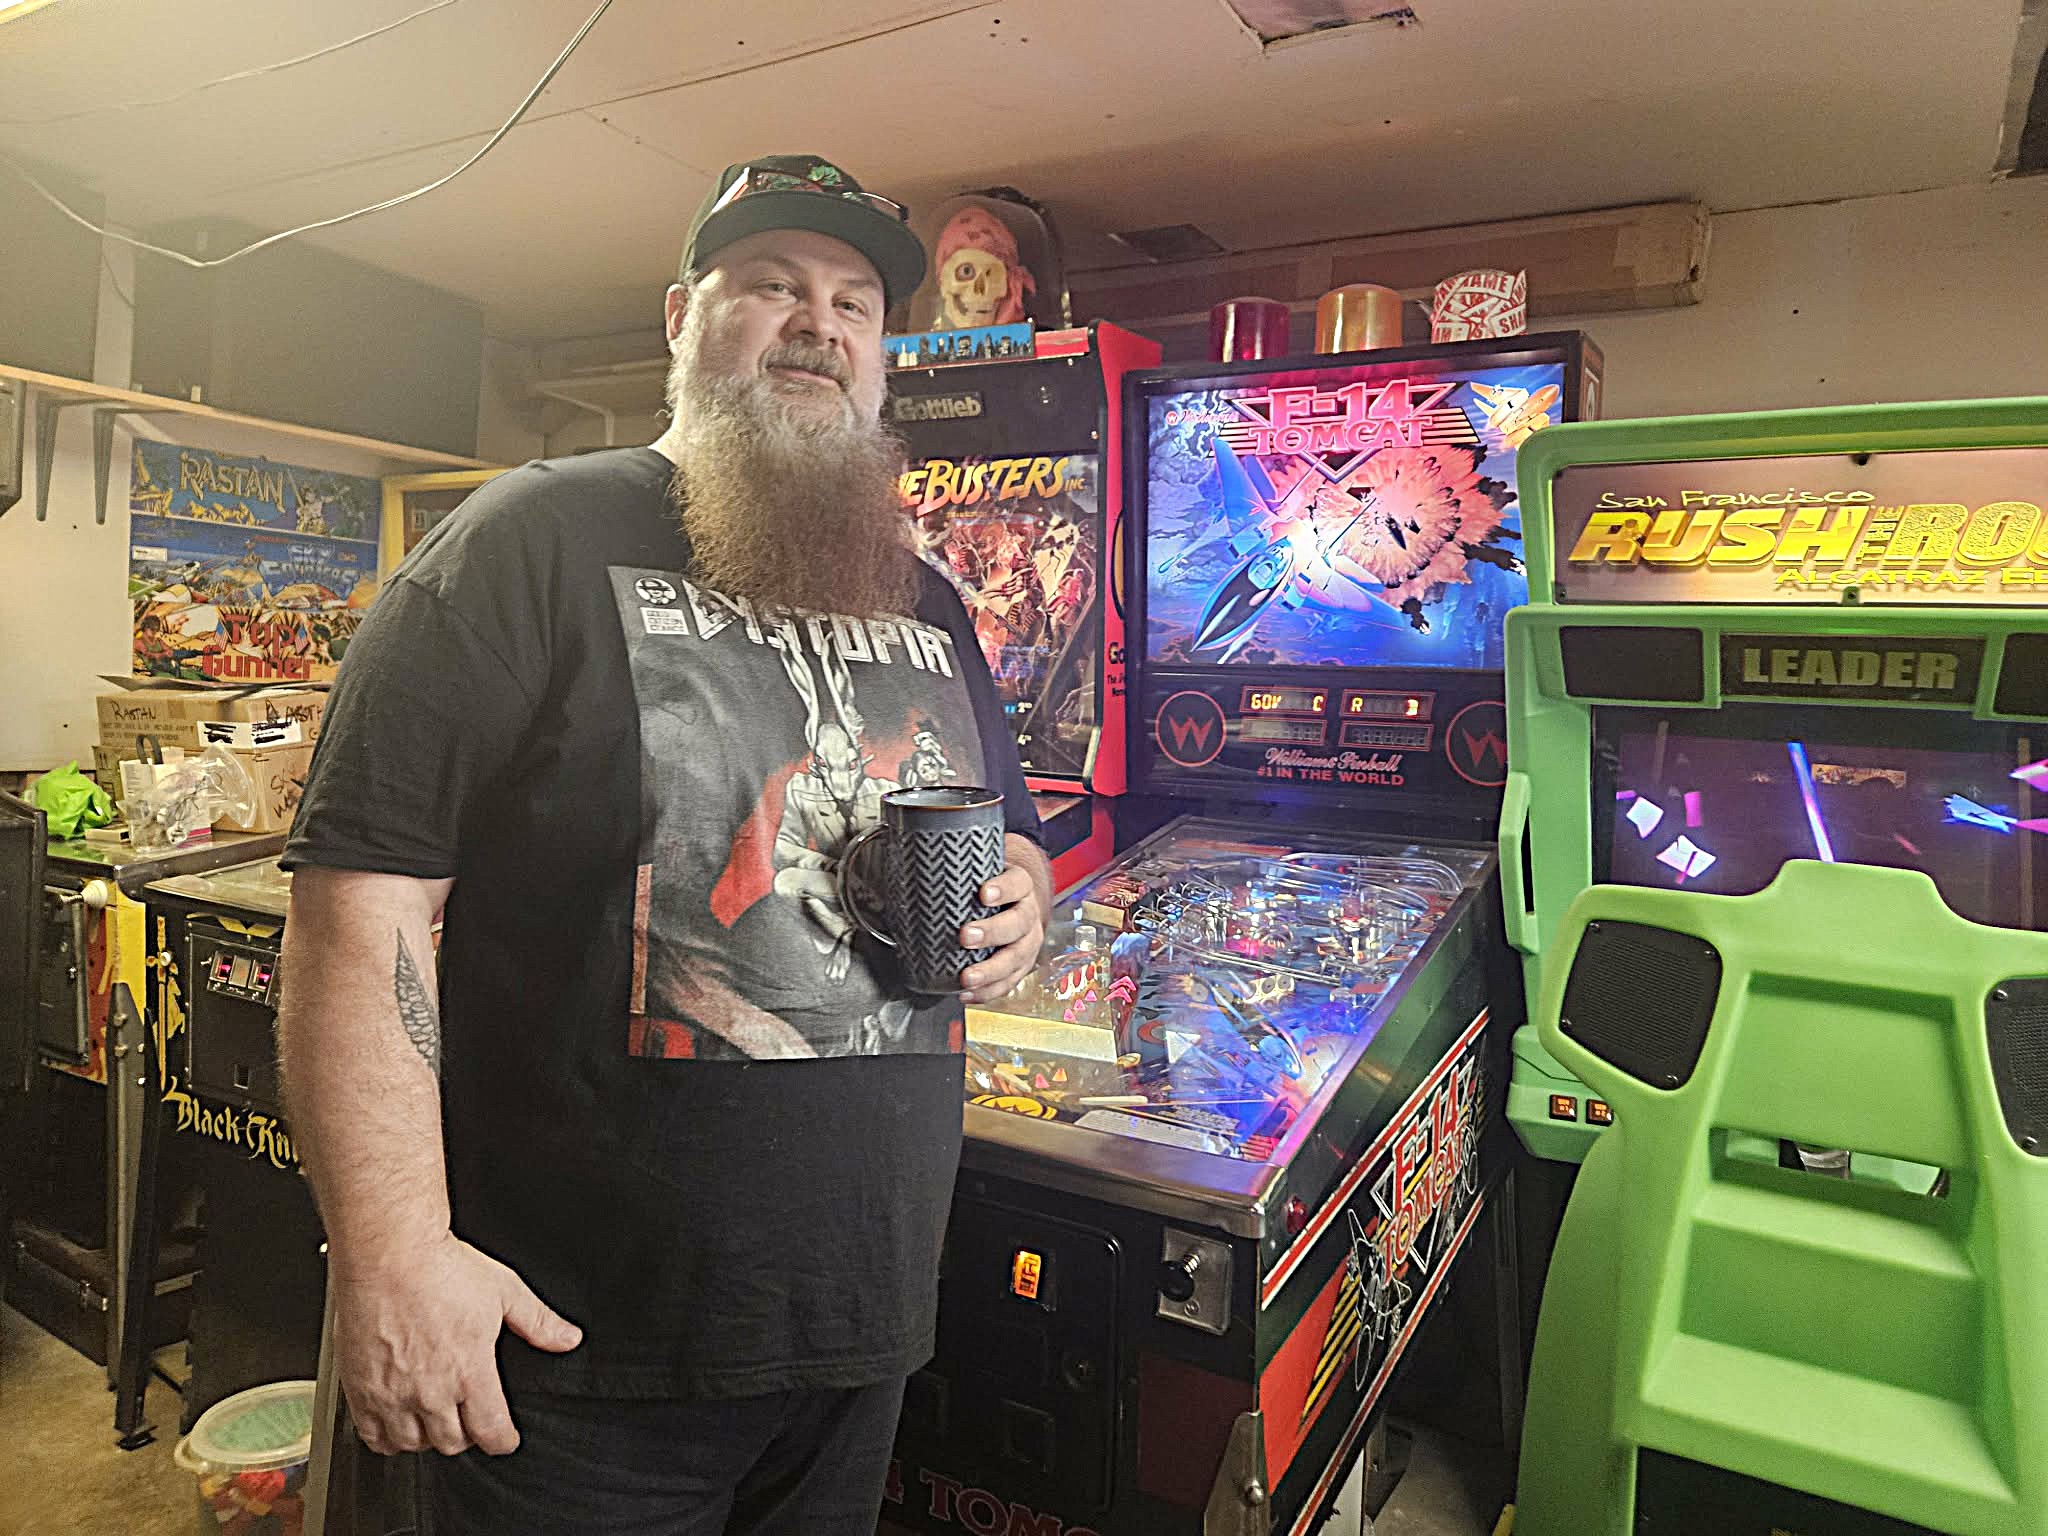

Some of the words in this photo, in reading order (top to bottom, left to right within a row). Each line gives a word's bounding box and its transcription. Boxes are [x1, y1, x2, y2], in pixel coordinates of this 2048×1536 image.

[895, 396, 981, 421] Gottlieb
[1268, 380, 1413, 426] F-14
[1249, 416, 1434, 456] TOMCAT
[178, 451, 286, 514] RASTAN
[897, 457, 1069, 517] EBUSTERS
[1595, 491, 1668, 508] San
[1680, 487, 1876, 507] Francisco
[1568, 506, 1872, 568] RUSH
[1856, 506, 1905, 566] THE
[1882, 501, 2048, 567] RO
[1775, 568, 1989, 586] ALCATRAZ
[202, 644, 315, 679] Gunner
[1743, 647, 1961, 690] LEADER
[1256, 765, 1273, 778] #1
[1275, 767, 1294, 780] IN
[1299, 769, 1334, 782] THE
[1337, 771, 1406, 787] WORLD
[1264, 747, 1338, 769] Williams
[1337, 751, 1405, 773] Pinball
[162, 1075, 241, 1145] Black
[1392, 1063, 1461, 1217] F-14
[1379, 1119, 1468, 1290] TOMCAT
